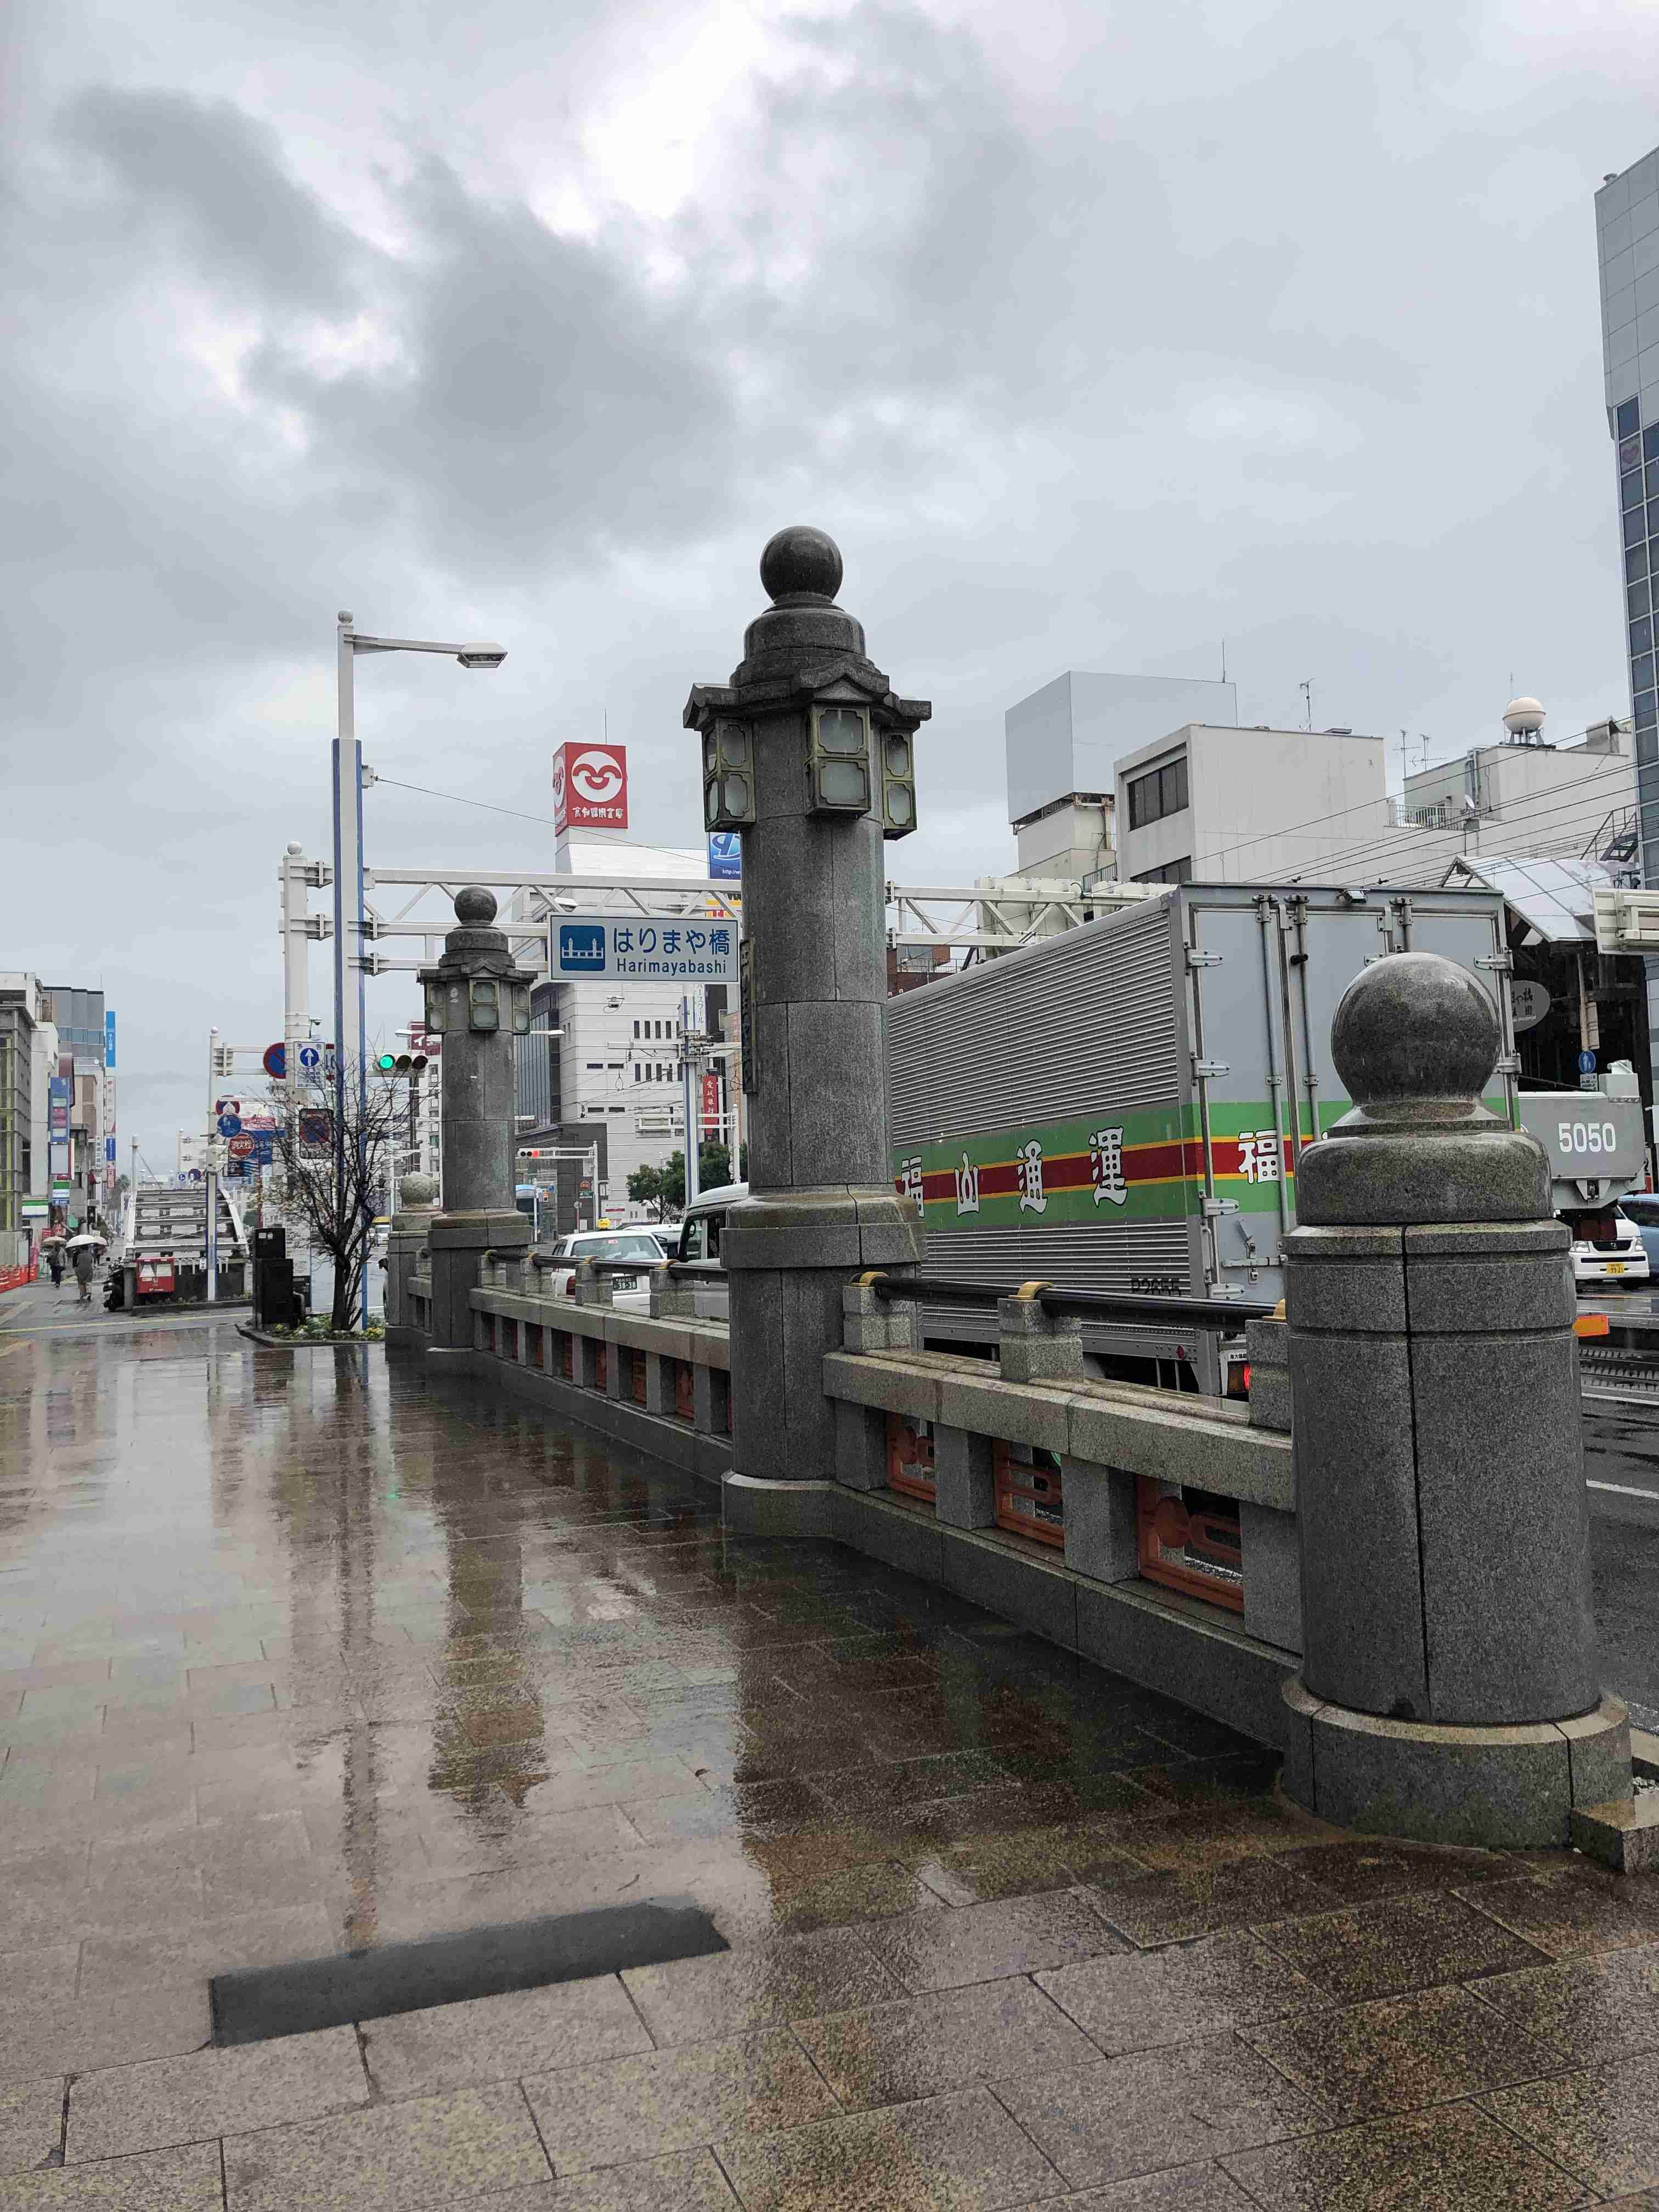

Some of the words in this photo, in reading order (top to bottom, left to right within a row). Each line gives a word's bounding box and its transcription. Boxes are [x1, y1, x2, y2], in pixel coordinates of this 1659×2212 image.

[613, 927, 730, 955] はりまや橋
[617, 958, 726, 976] Harimayabashi
[230, 1139, 252, 1150] 消火栓
[1559, 1122, 1616, 1153] 5050
[901, 1126, 1128, 1217] 福山通運
